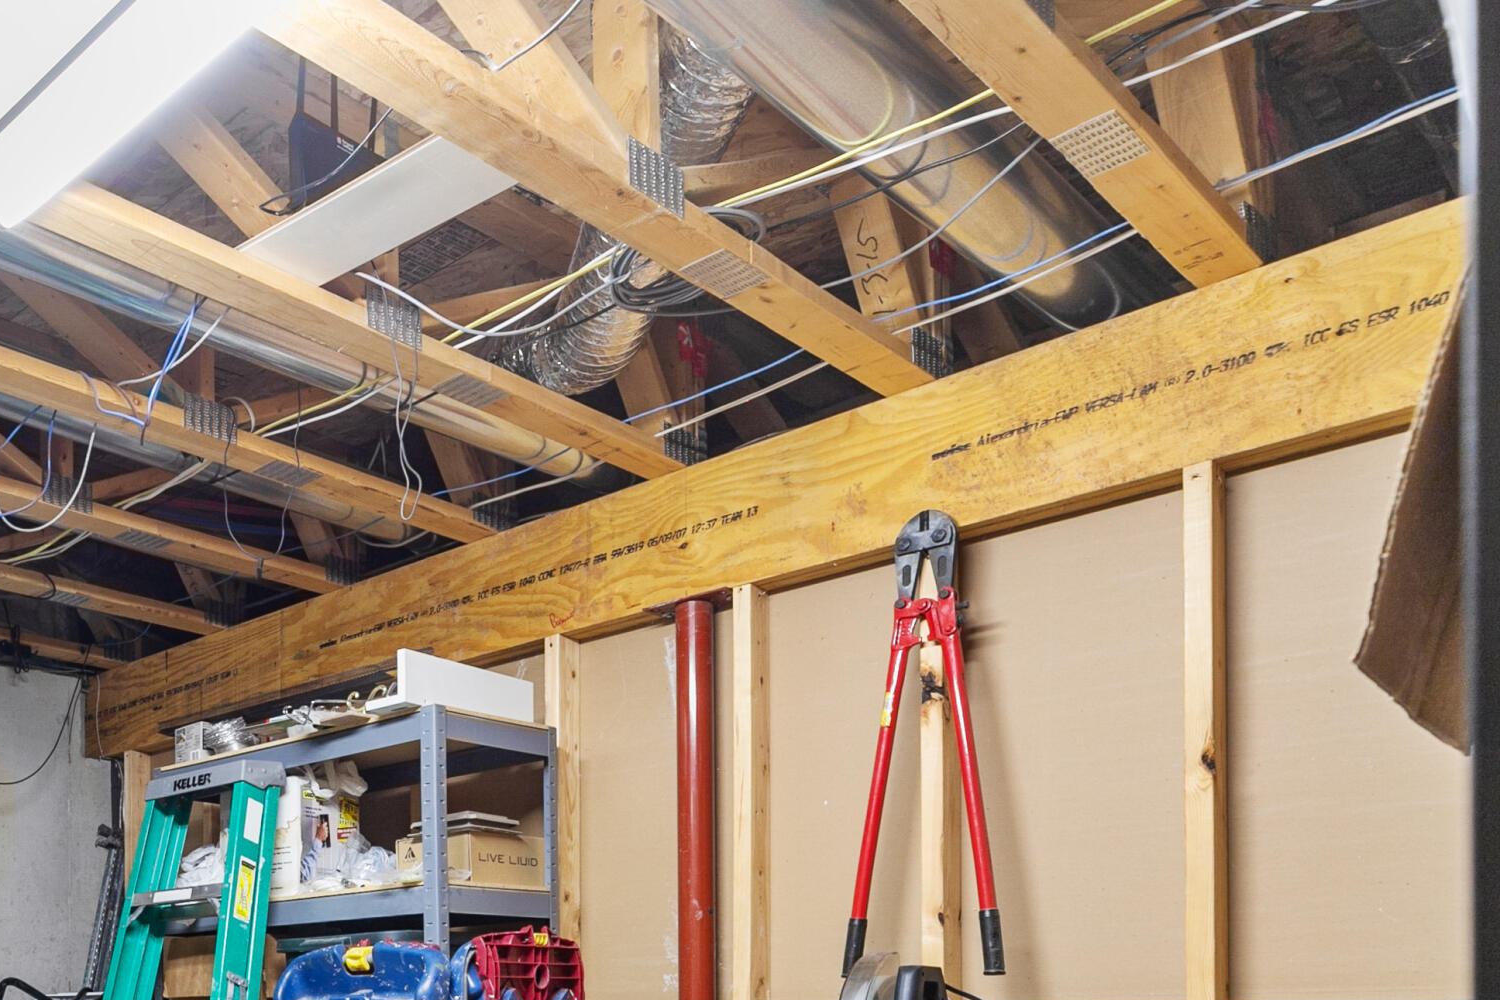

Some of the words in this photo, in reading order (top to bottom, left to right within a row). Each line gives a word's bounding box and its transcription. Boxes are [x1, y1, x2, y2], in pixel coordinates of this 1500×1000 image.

[1303, 327, 1331, 348] ICC
[1366, 305, 1400, 329] ESR
[173, 772, 213, 792] KELLER
[478, 852, 505, 864] LIVE
